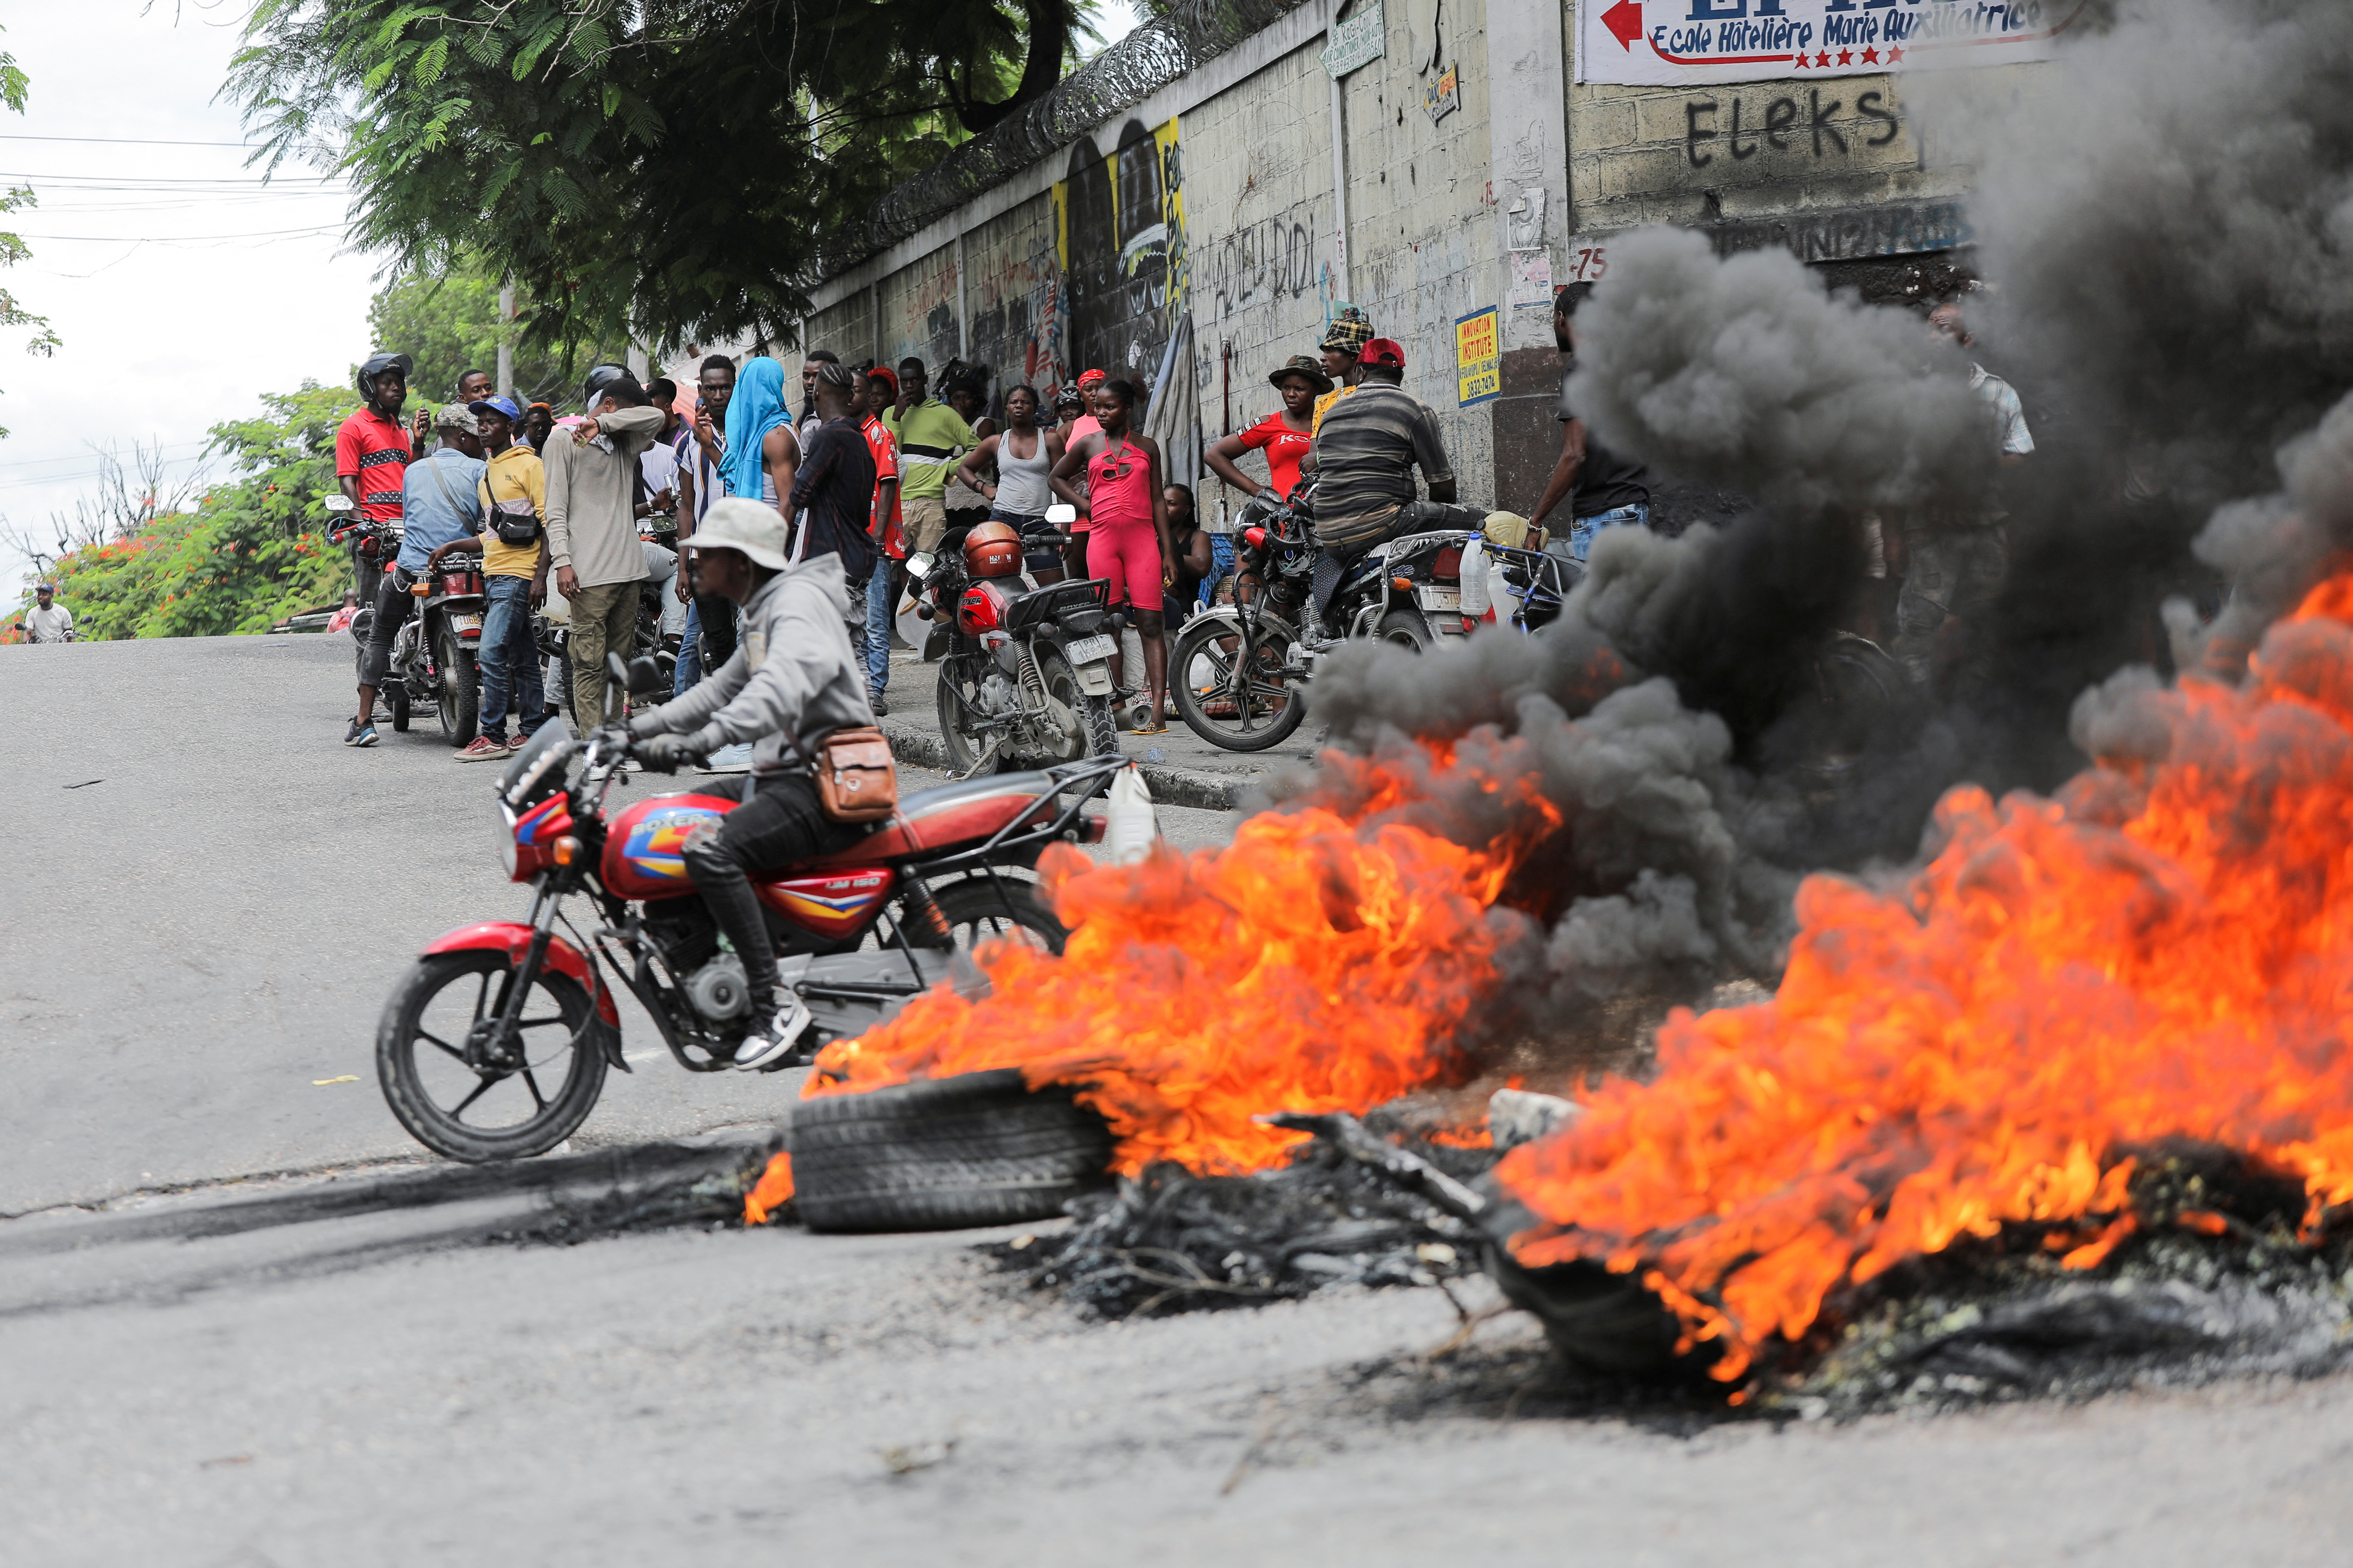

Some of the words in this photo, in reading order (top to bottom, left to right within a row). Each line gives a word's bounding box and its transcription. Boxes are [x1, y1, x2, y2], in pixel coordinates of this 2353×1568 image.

[1654, 22, 1712, 53] Ecole
[1718, 17, 1812, 53] Hôtelière
[1823, 10, 1879, 46] Marie
[1883, 1, 2042, 42] Auxiliatrice
[1462, 315, 1490, 340] INNOVATION
[1462, 335, 1492, 361] INSTITUTE
[1467, 374, 1495, 399] 3832-7474
[960, 596, 982, 605] OXER
[630, 813, 704, 836] BOXER
